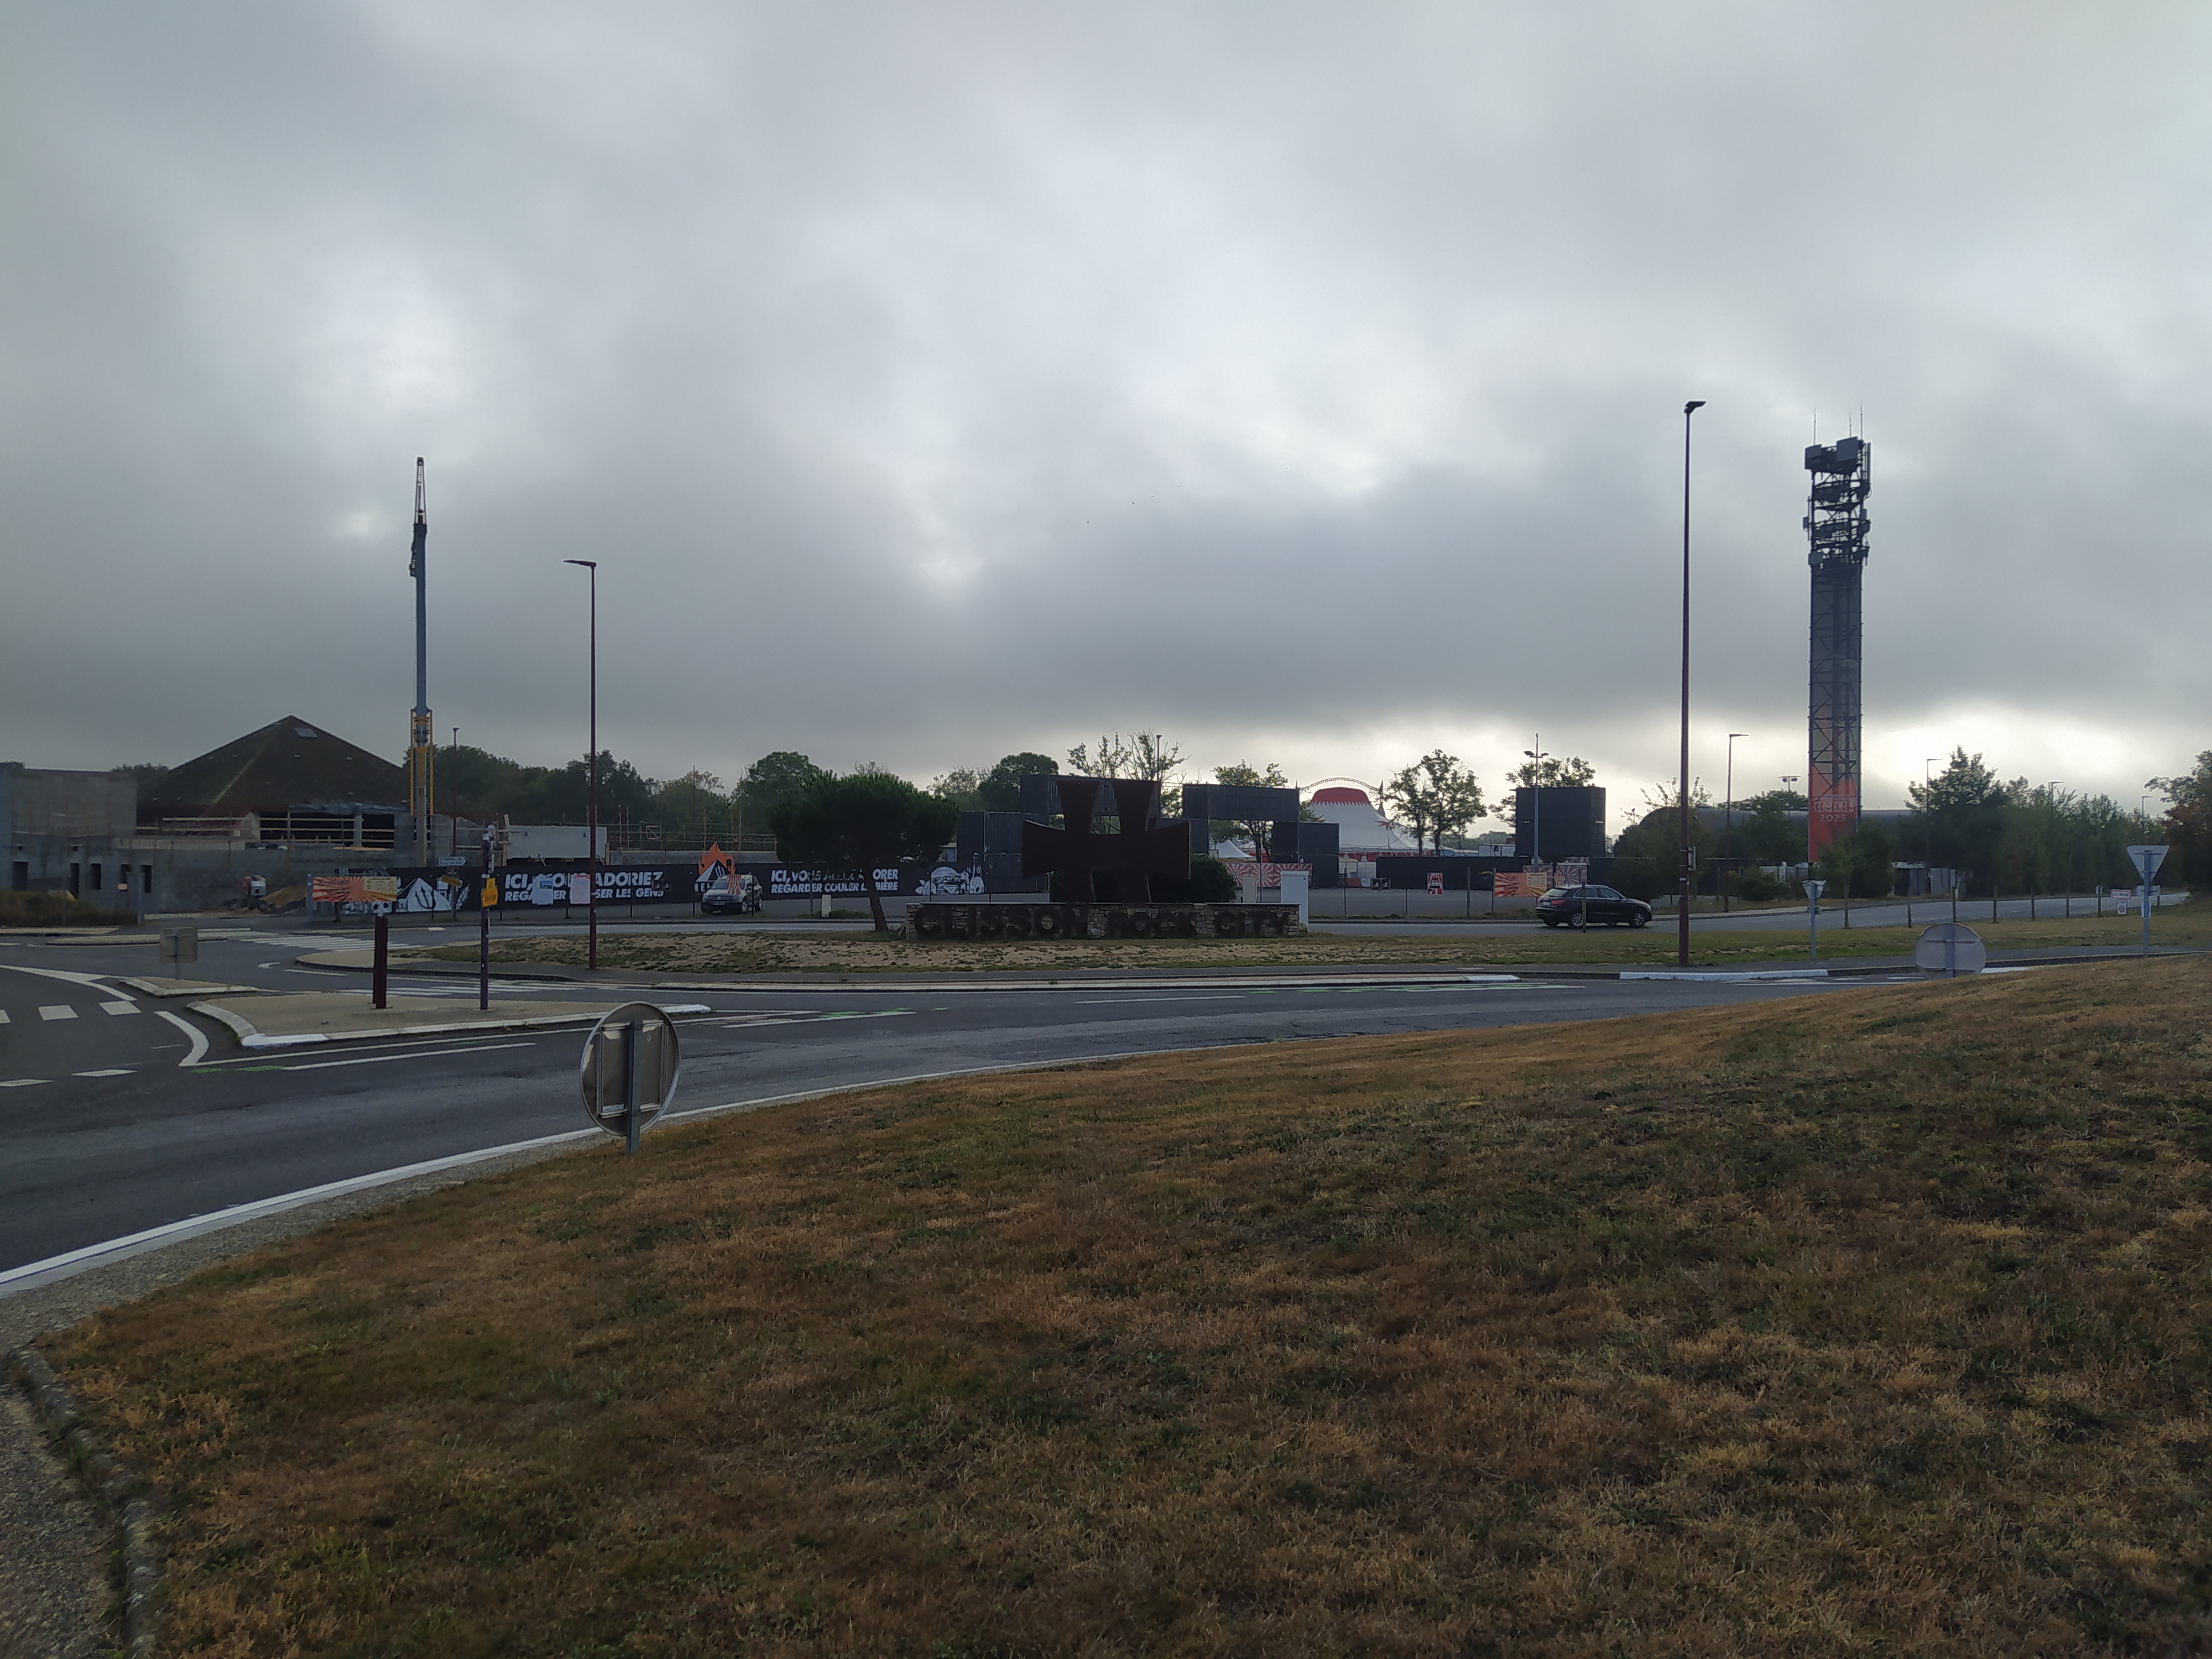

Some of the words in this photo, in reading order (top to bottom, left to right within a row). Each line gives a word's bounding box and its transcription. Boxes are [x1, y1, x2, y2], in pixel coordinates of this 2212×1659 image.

[1820, 814, 1845, 822] 2025
[504, 873, 533, 891] ICI,
[596, 872, 664, 888] ADORIEZ
[770, 869, 791, 884] ICI,
[771, 882, 822, 894] REGARDER
[824, 882, 859, 892] COULER
[914, 905, 1088, 939] CLISSON
[1106, 909, 1199, 939] ROCK
[1215, 909, 1288, 939] CITY
